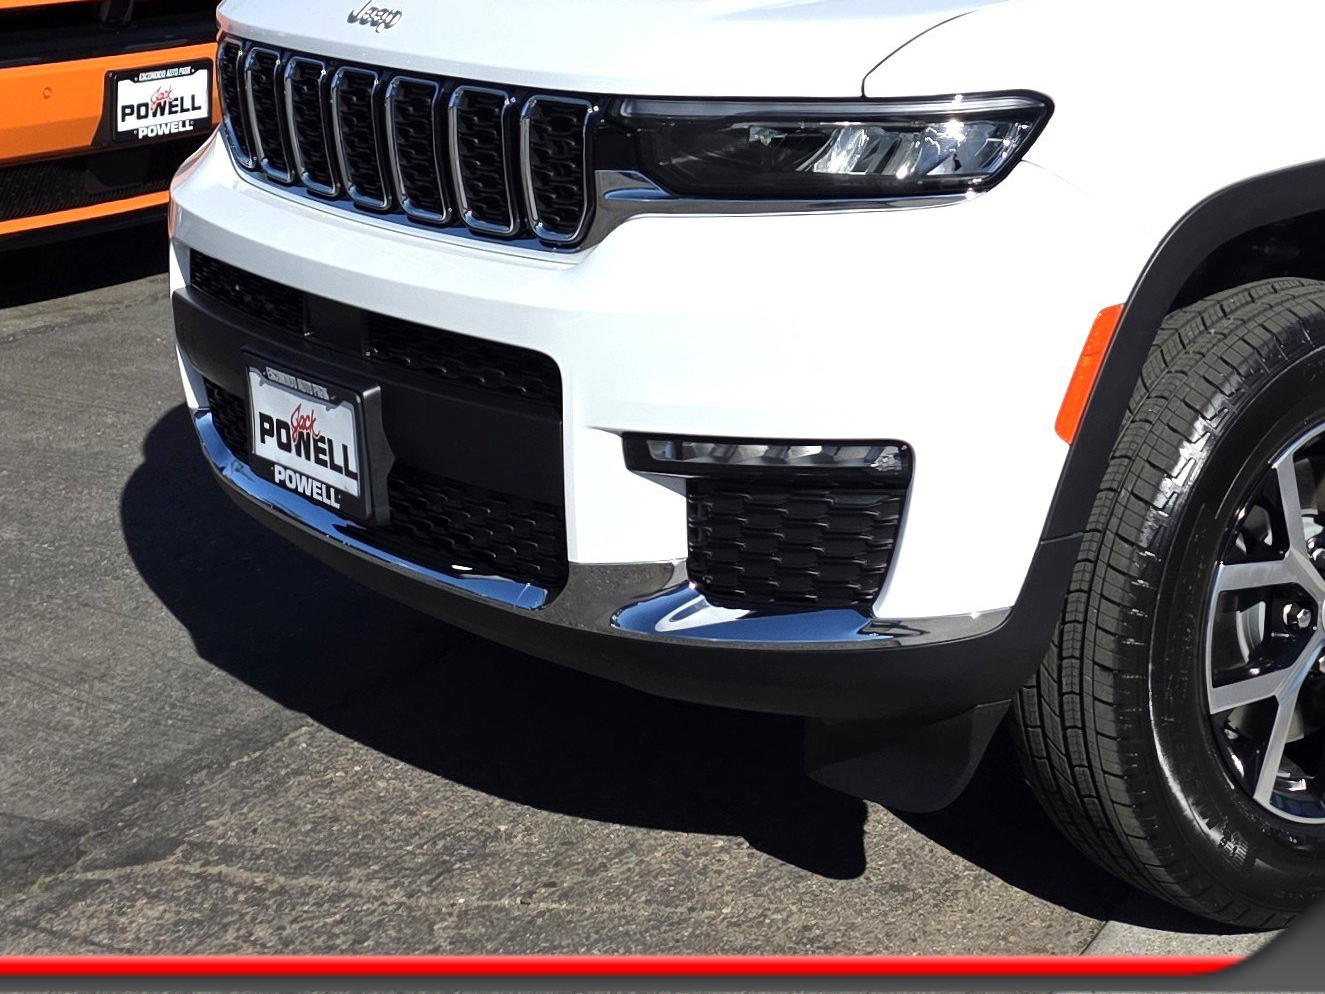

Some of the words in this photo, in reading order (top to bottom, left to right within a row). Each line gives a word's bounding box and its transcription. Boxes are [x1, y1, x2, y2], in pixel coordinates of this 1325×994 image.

[121, 94, 202, 123] POWELL
[138, 119, 194, 140] POWELL
[290, 402, 321, 445] Jack
[258, 411, 359, 481] POWELL
[274, 464, 341, 510] POWELL
